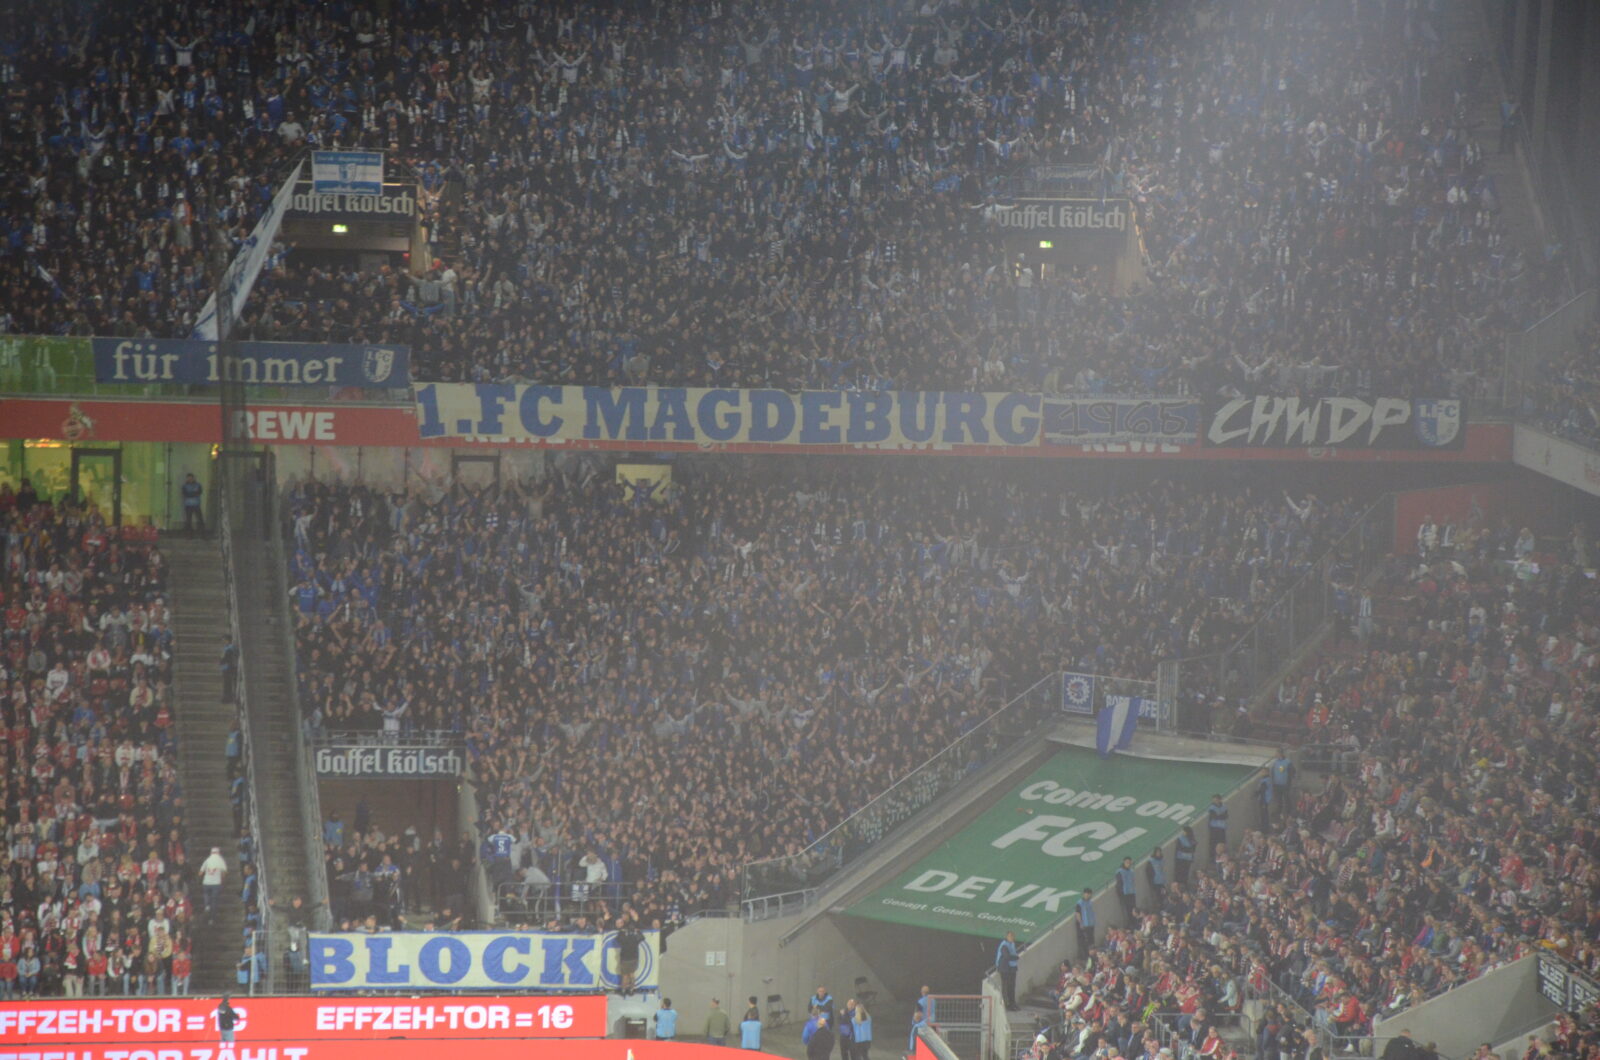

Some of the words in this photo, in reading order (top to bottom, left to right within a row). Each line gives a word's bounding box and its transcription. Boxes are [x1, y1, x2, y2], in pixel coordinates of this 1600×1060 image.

[1059, 206, 1127, 232] Kölsch
[113, 341, 179, 381] für
[207, 345, 343, 384] immer
[232, 410, 336, 441] REWE
[582, 386, 1042, 445] MAGDEBURG
[1057, 400, 1188, 437] 1965
[1207, 394, 1412, 446] CHWDP
[316, 748, 383, 776] Gaffel
[387, 749, 461, 777] Kölsch
[1020, 780, 1136, 813] Come
[991, 815, 1147, 862] FC!
[903, 869, 1081, 913] DEVK
[310, 936, 595, 985] BLOCK
[316, 1005, 510, 1031] EFFZEH-TOR
